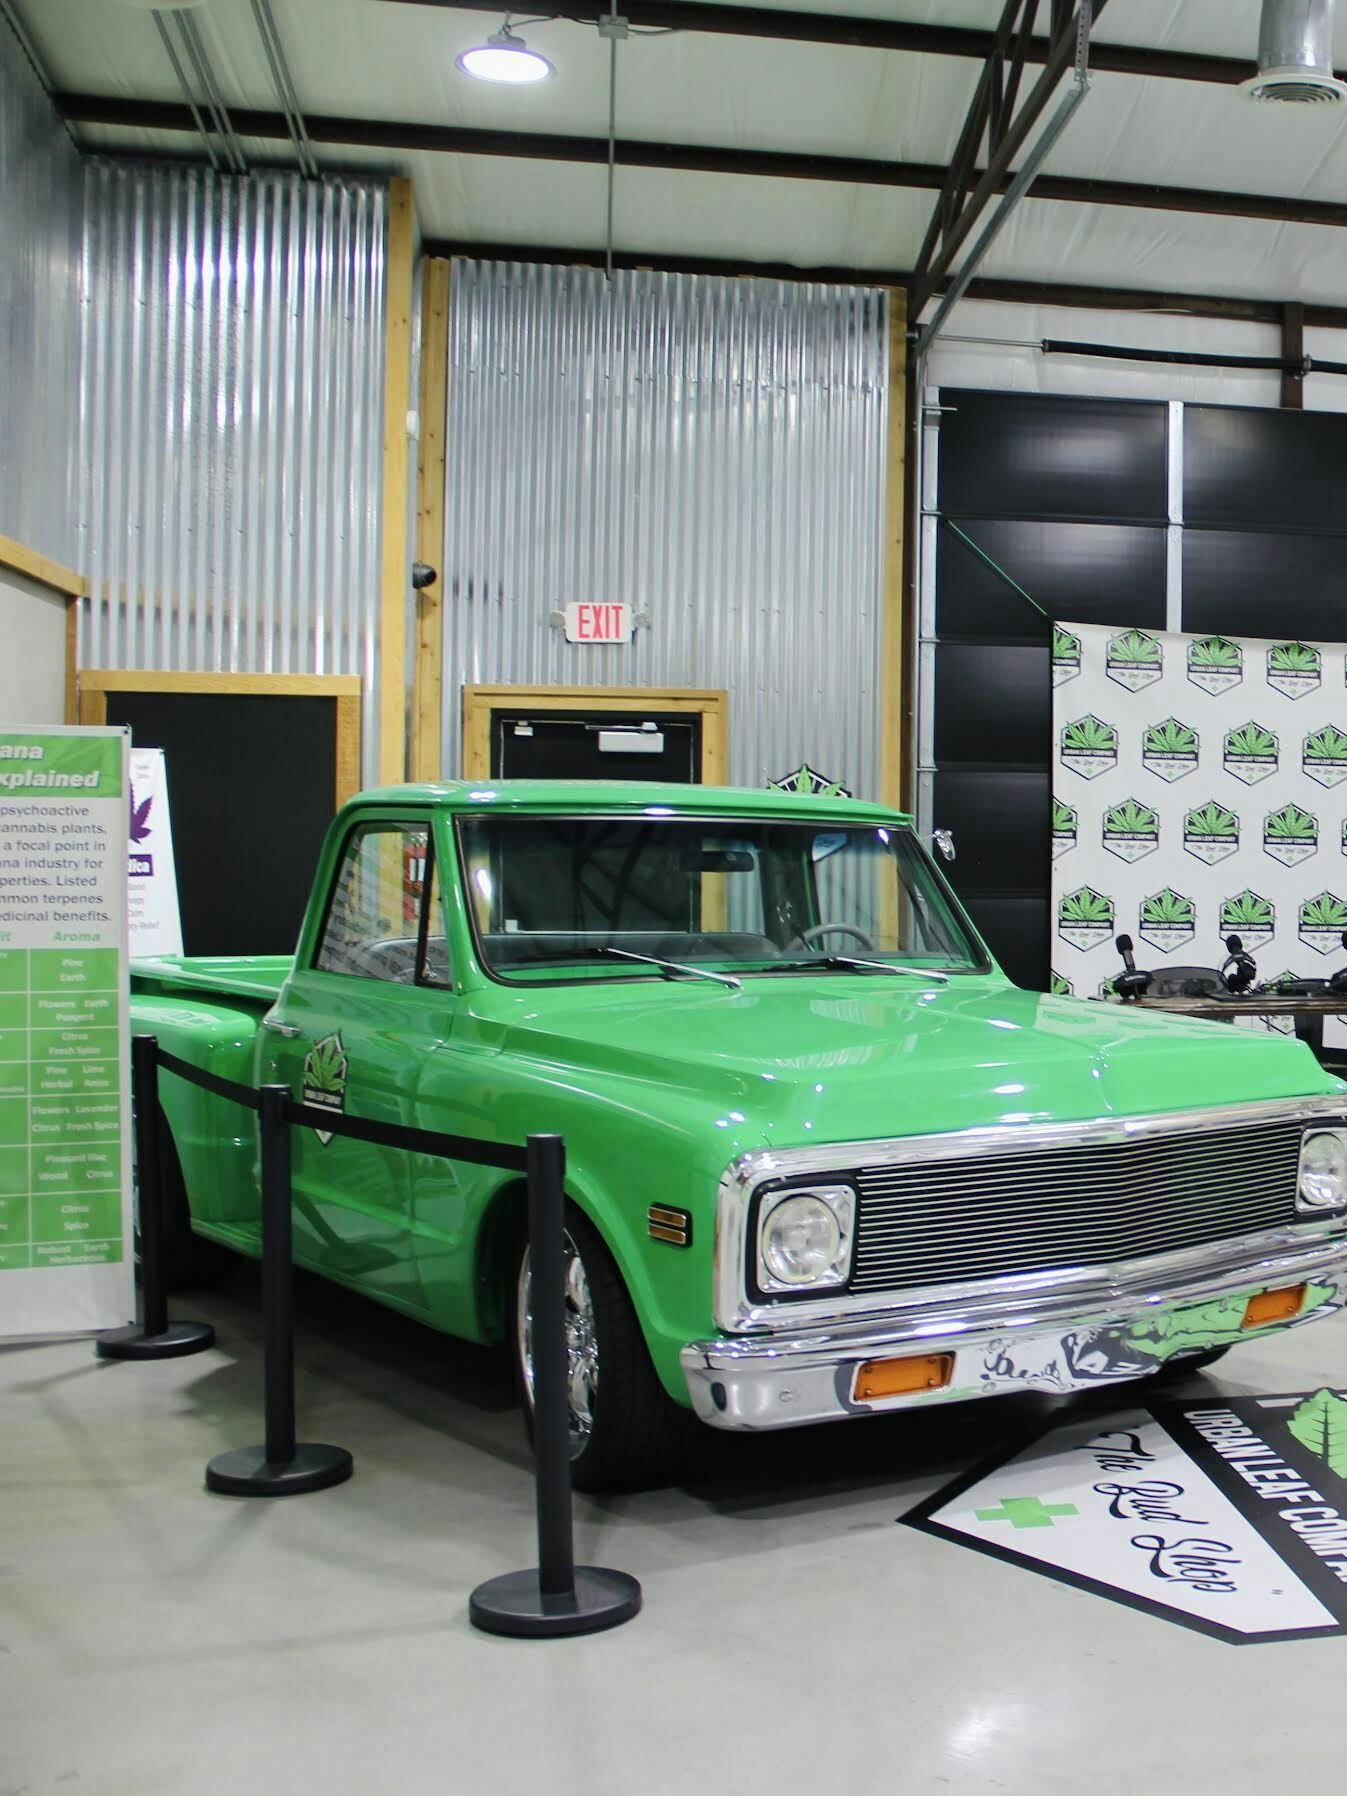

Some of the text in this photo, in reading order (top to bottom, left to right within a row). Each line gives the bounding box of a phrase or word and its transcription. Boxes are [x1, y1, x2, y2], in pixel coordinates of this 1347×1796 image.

[578, 605, 623, 639] EXIT
[0, 745, 43, 759] ana
[0, 769, 99, 789] xplained
[0, 806, 89, 818] psychoactive
[3, 840, 107, 853] a focal point in
[0, 857, 104, 871] na industry for
[0, 875, 97, 888] perties. Listed
[42, 894, 105, 906] terpenes
[53, 910, 112, 921] benefits.
[53, 932, 101, 942] Aroma
[1183, 1409, 1276, 1459] URBAN
[1229, 1458, 1325, 1503] LEAF
[1074, 1431, 1242, 1593] The Bud Shop
